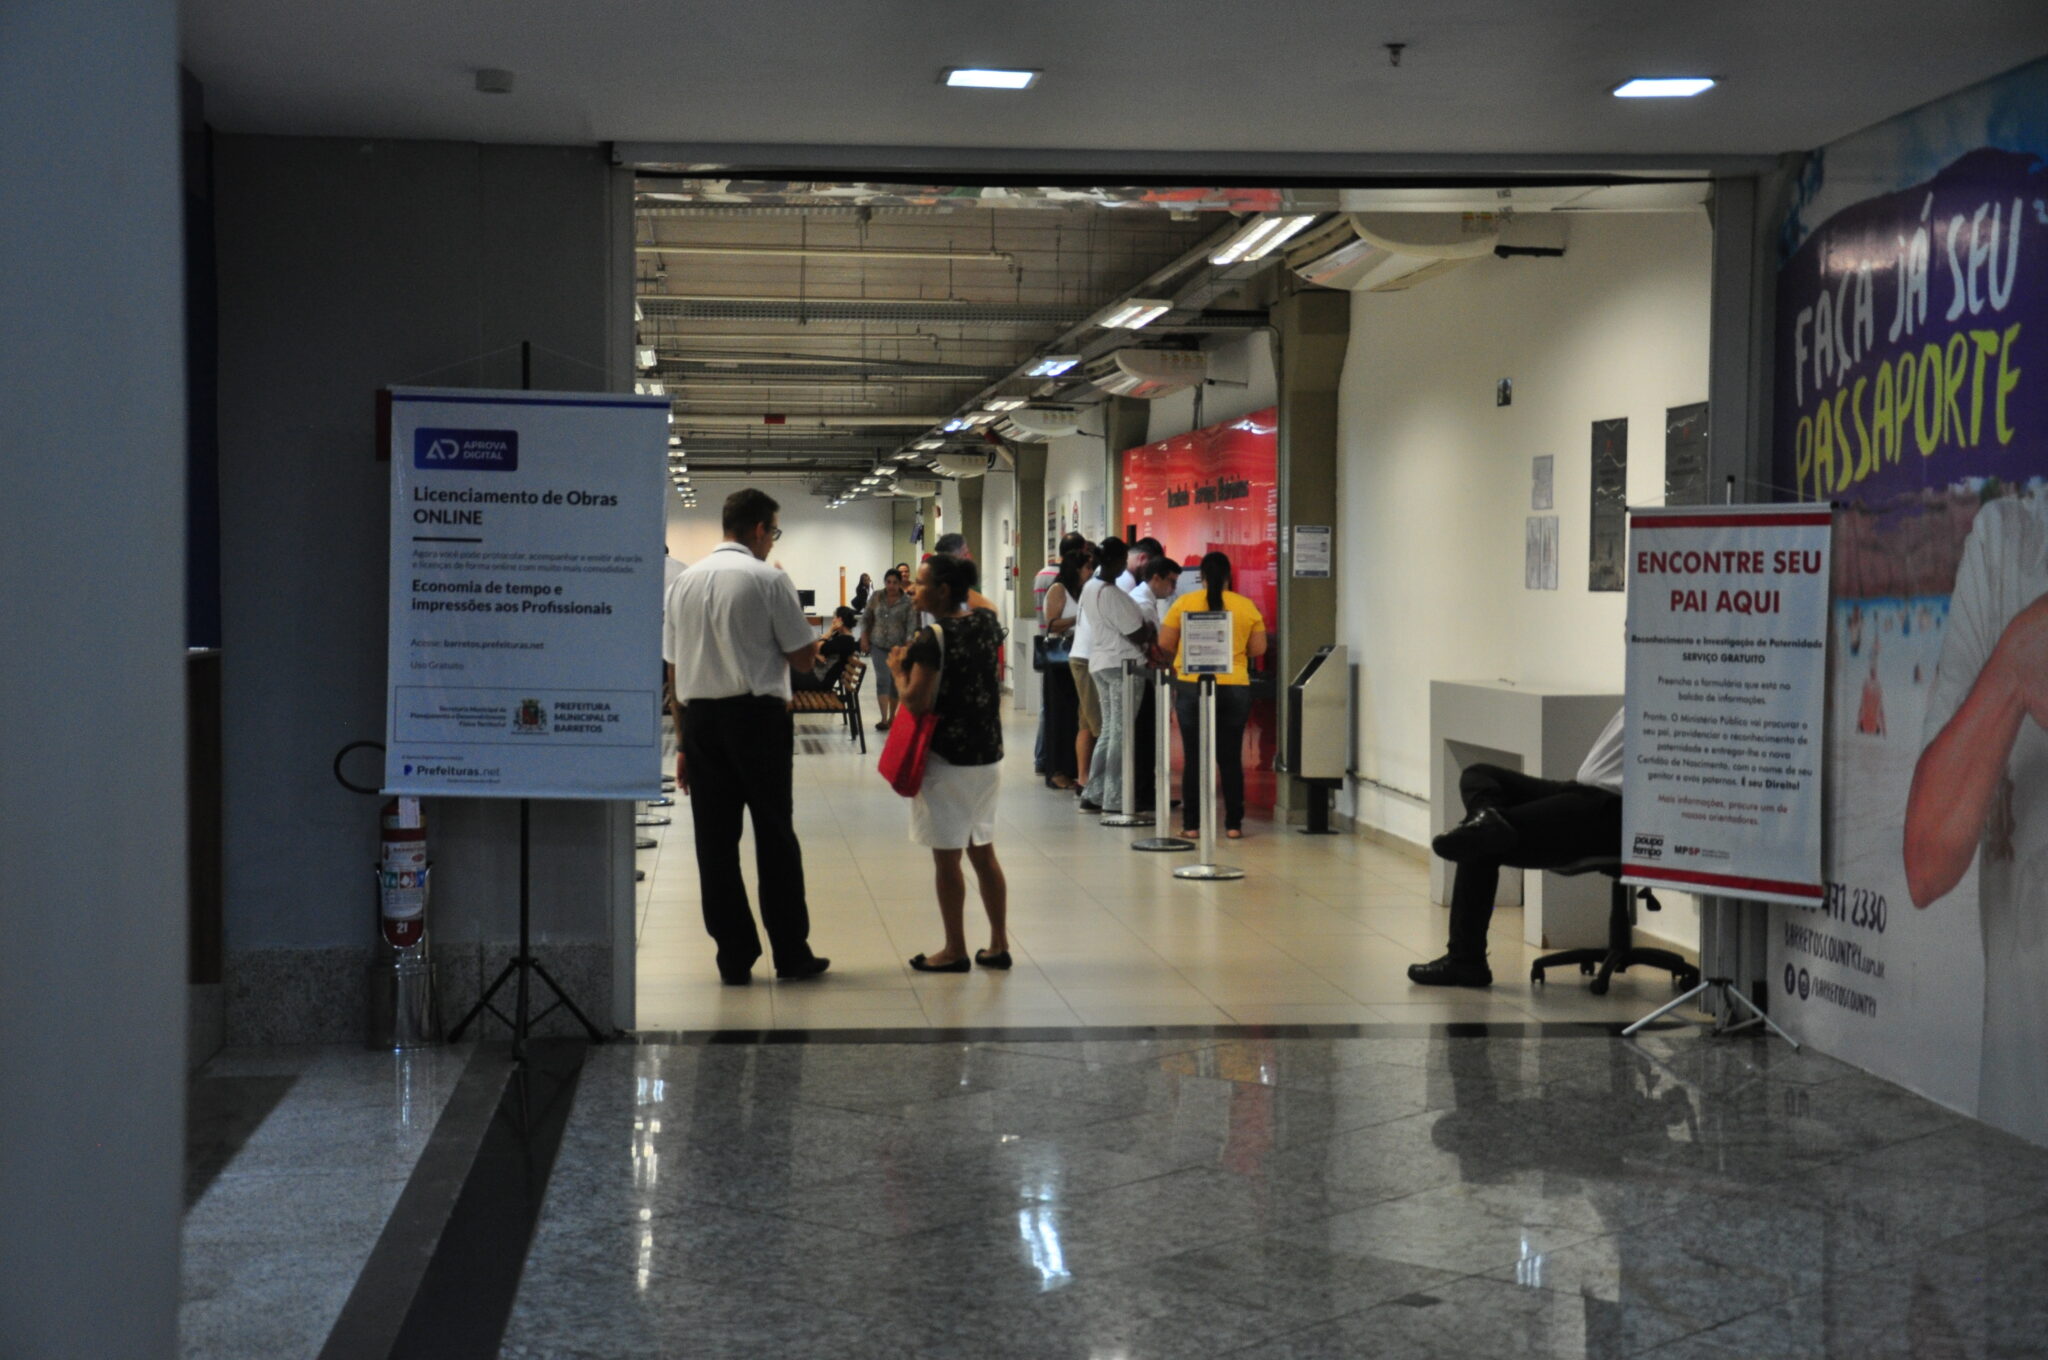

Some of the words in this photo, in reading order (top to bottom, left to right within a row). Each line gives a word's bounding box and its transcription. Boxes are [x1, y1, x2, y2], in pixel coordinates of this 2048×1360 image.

[1795, 259, 1874, 407] FAÇA
[1889, 192, 1933, 343] JÁ
[1946, 197, 2022, 322] SEU
[1795, 322, 2021, 502] PASSAPORTE
[463, 440, 508, 450] APROVA
[463, 451, 503, 461] DIGITAL
[413, 487, 538, 506] Licenciamento
[542, 490, 563, 506] de
[566, 491, 618, 506] Obras
[413, 510, 483, 525] ONLINE
[1637, 551, 1764, 573] ENCONTRE
[1773, 551, 1821, 574] SEU
[412, 579, 482, 594] Economia
[485, 581, 502, 594] de
[506, 582, 551, 597] tempo
[554, 585, 563, 595] e
[411, 598, 492, 613] Impressões
[495, 602, 519, 613] aos
[522, 600, 612, 615] Profissionais
[1670, 590, 1707, 612] PAI
[1716, 590, 1780, 615] AQUI
[1631, 635, 1693, 645] Reconhecimento
[1757, 638, 1767, 647] de
[1769, 637, 1823, 649] Paternidade
[1682, 652, 1718, 664] SERVIÇO
[1721, 653, 1766, 664] GRATUITO
[1705, 693, 1715, 702] de
[554, 702, 611, 711] PREFEITURA
[554, 712, 605, 722] MUNICIPAL
[607, 713, 620, 722] DE
[1680, 712, 1717, 724] Ministério
[554, 724, 603, 733] BARRETOS
[1730, 732, 1795, 745] reconhecimento
[417, 765, 500, 777] Prefeituras.net
[1671, 757, 1681, 767] de
[1785, 765, 1796, 775] de
[1749, 780, 1763, 788] seu
[1674, 845, 1700, 856] MPSP
[1853, 887, 1888, 933] 2330
